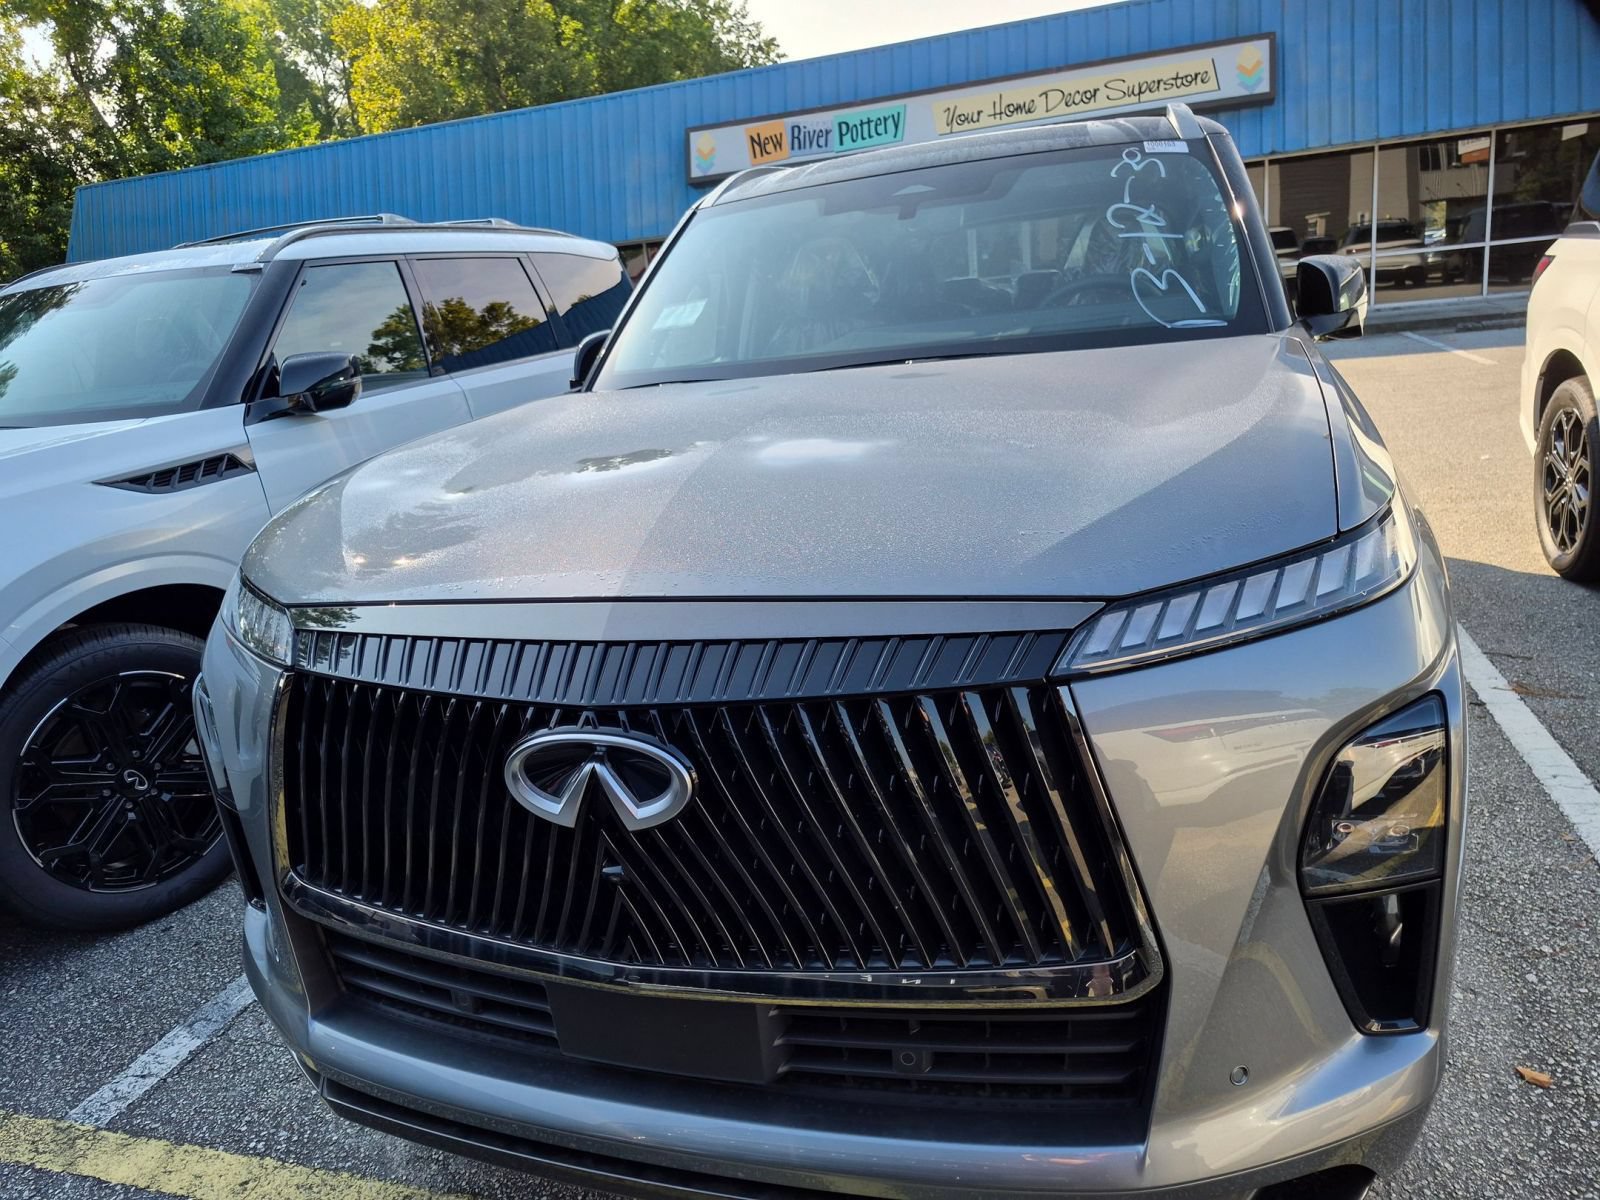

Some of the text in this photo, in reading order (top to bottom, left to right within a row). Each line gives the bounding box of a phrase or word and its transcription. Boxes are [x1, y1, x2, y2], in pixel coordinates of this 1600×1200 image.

[943, 68, 1211, 133] Your Home Decor Superstore
[749, 111, 901, 160] New River Pottery
